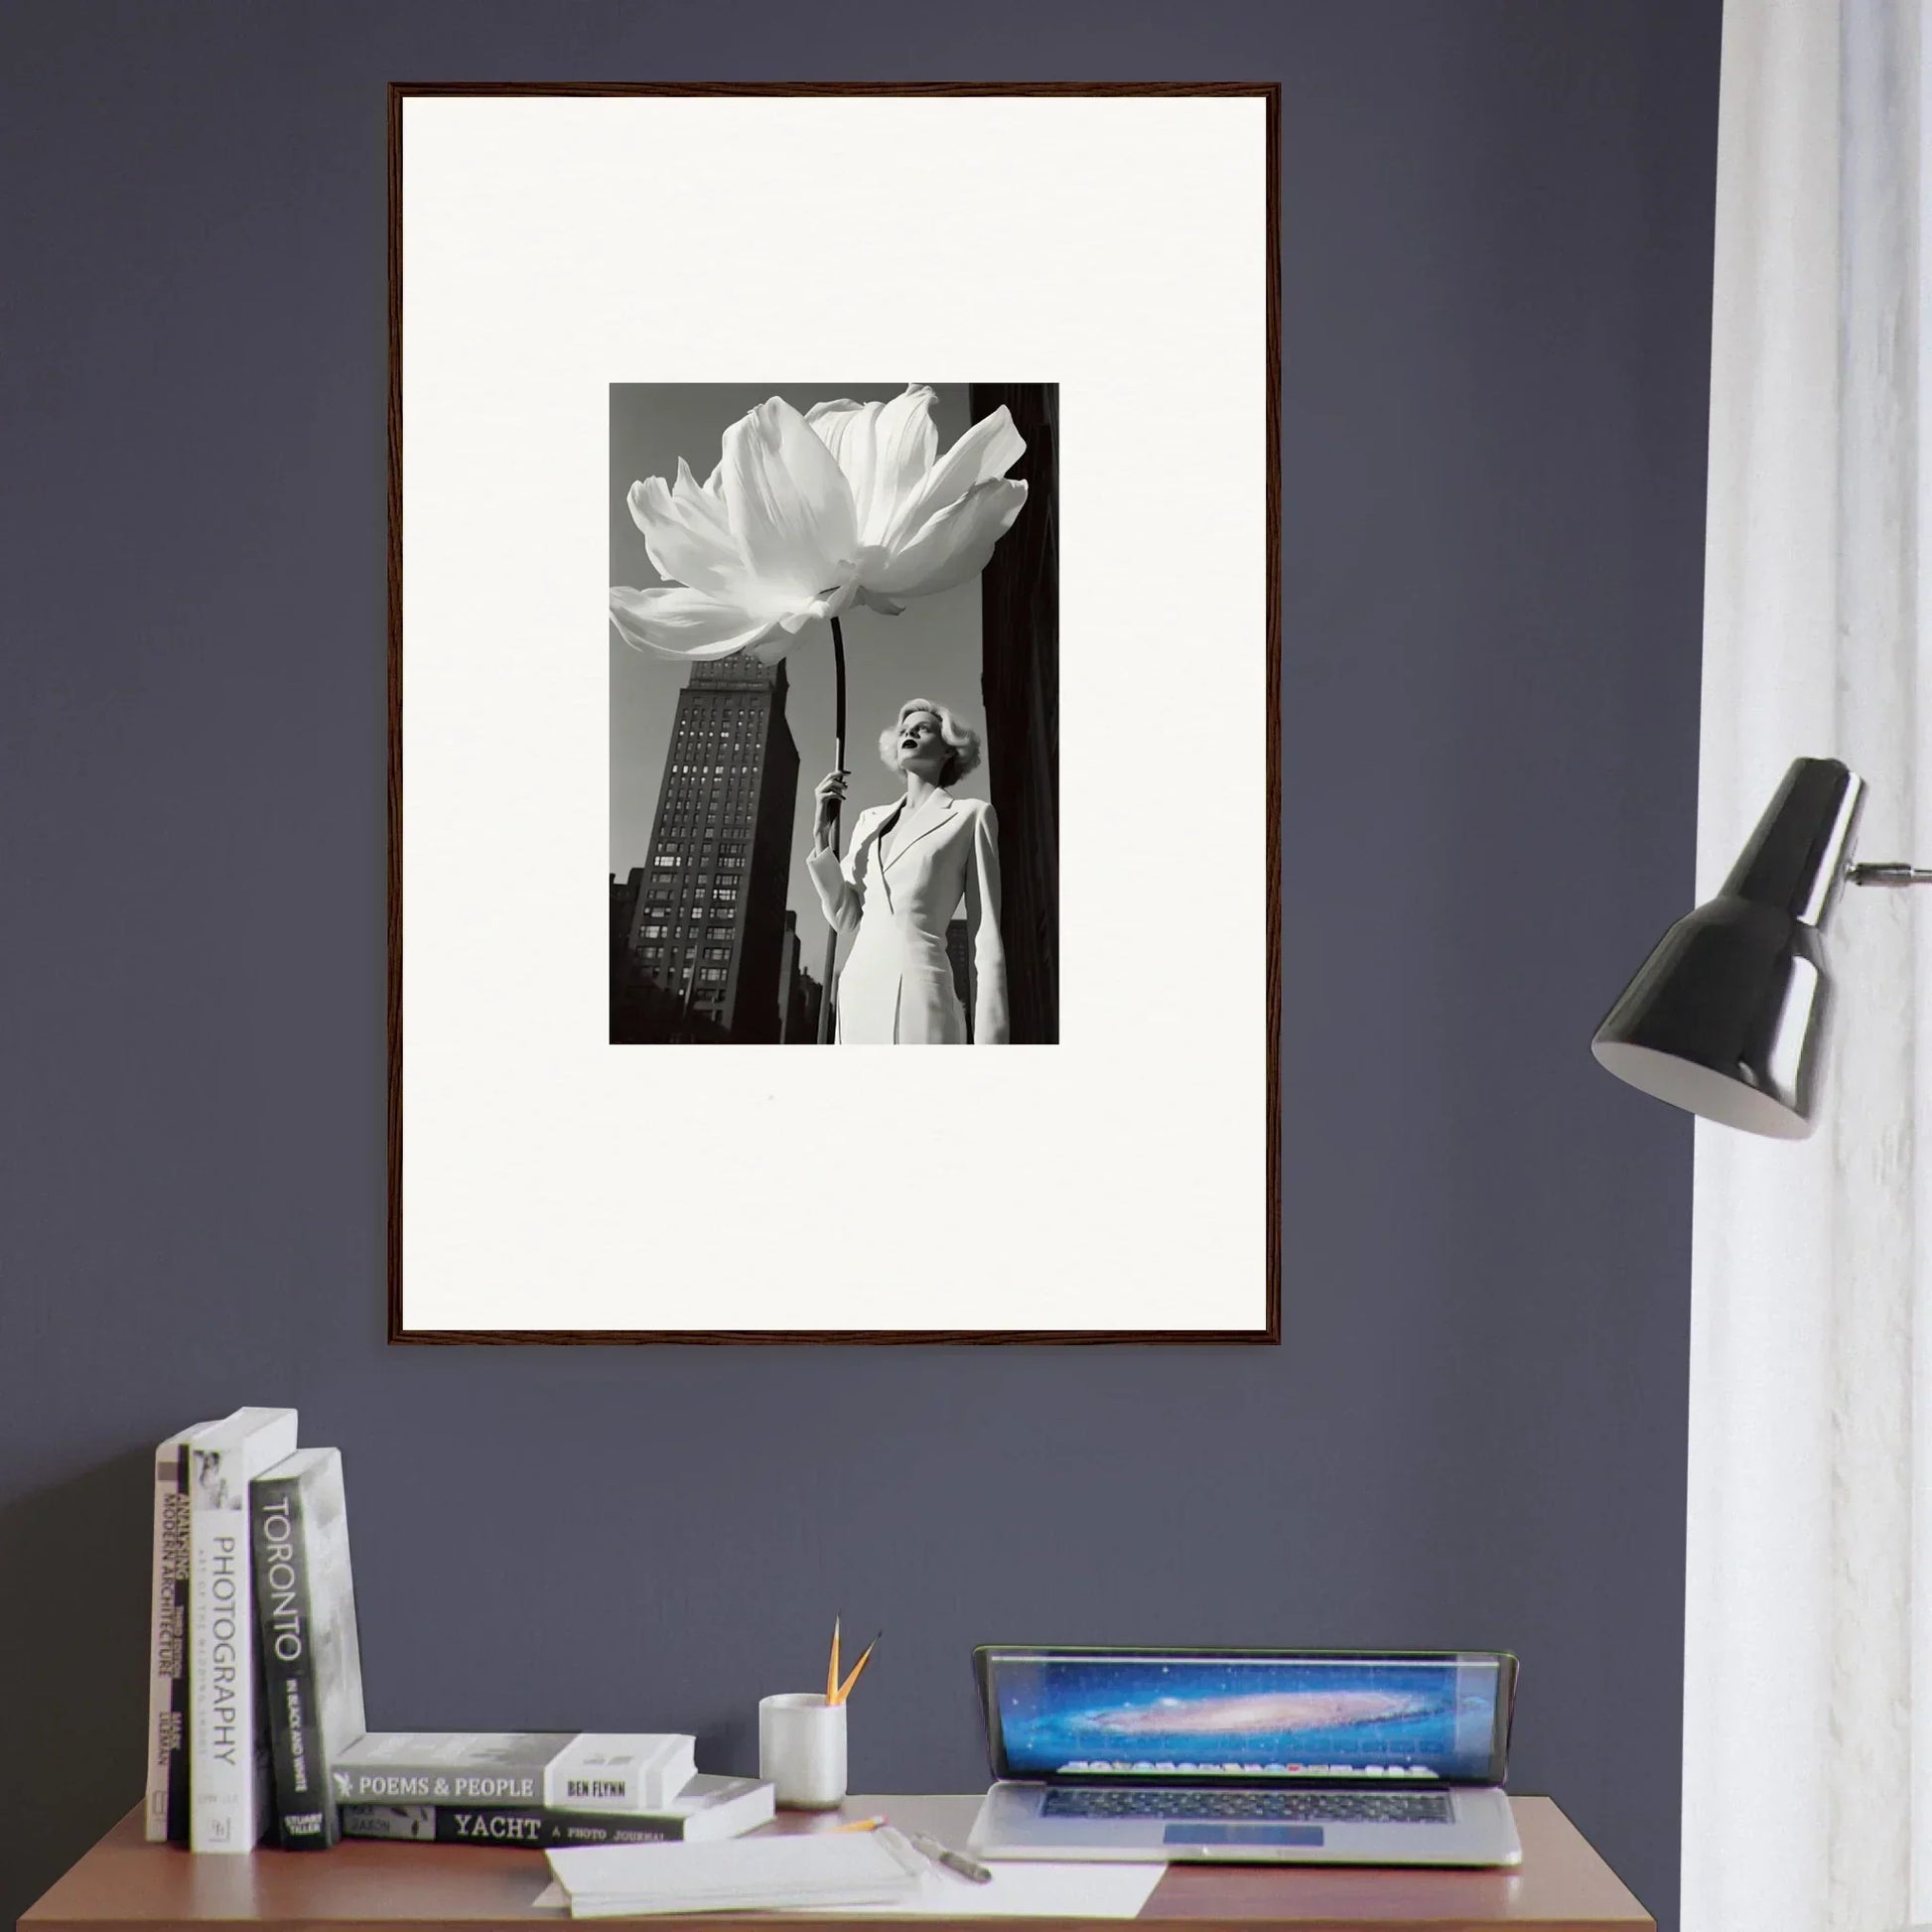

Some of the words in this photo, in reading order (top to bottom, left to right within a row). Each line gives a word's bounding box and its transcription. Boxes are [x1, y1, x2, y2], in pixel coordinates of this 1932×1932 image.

[163, 1493, 176, 1561] MODERN
[262, 1497, 302, 1661] TORONTO
[158, 1566, 175, 1678] ARCHITECTURE
[212, 1537, 235, 1766] PHOTOGRAPHY
[288, 1694, 302, 1729] BLACK
[291, 1730, 304, 1755] AND
[294, 1756, 309, 1792] WHITE
[359, 1776, 429, 1796] POEMS
[434, 1777, 450, 1796] &
[455, 1777, 534, 1797] PEOPLE
[567, 1779, 589, 1797] BEN
[593, 1779, 625, 1797] FLYNN
[454, 1814, 542, 1840] YACHT
[551, 1826, 561, 1837] A
[567, 1827, 607, 1840] PHOTO
[613, 1829, 665, 1843] JOURNAL
